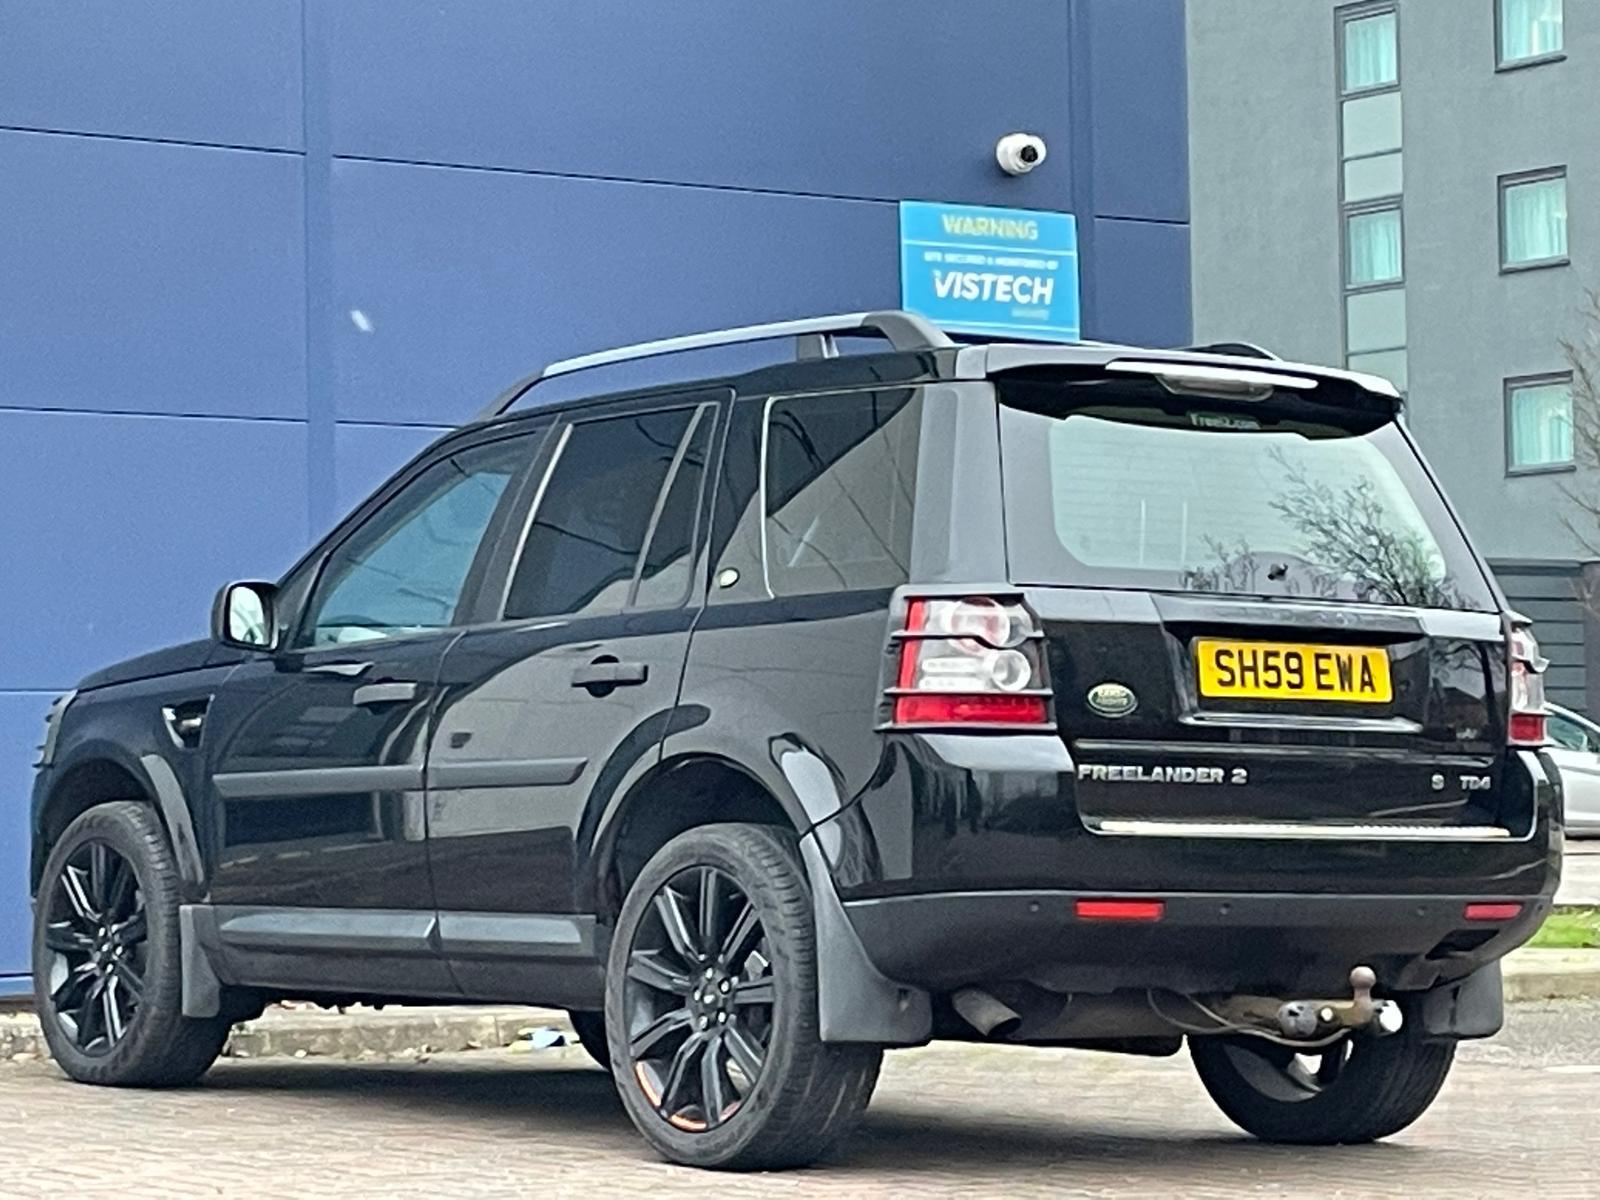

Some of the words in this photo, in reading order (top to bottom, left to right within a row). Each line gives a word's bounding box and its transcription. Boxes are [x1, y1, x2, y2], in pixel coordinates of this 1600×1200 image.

[941, 213, 1039, 241] WARNING
[932, 269, 1054, 305] VISTECH
[1214, 648, 1305, 690] SH59
[1313, 652, 1377, 693] EWA
[1077, 763, 1225, 784] FREELANDER
[1231, 768, 1248, 785] 2
